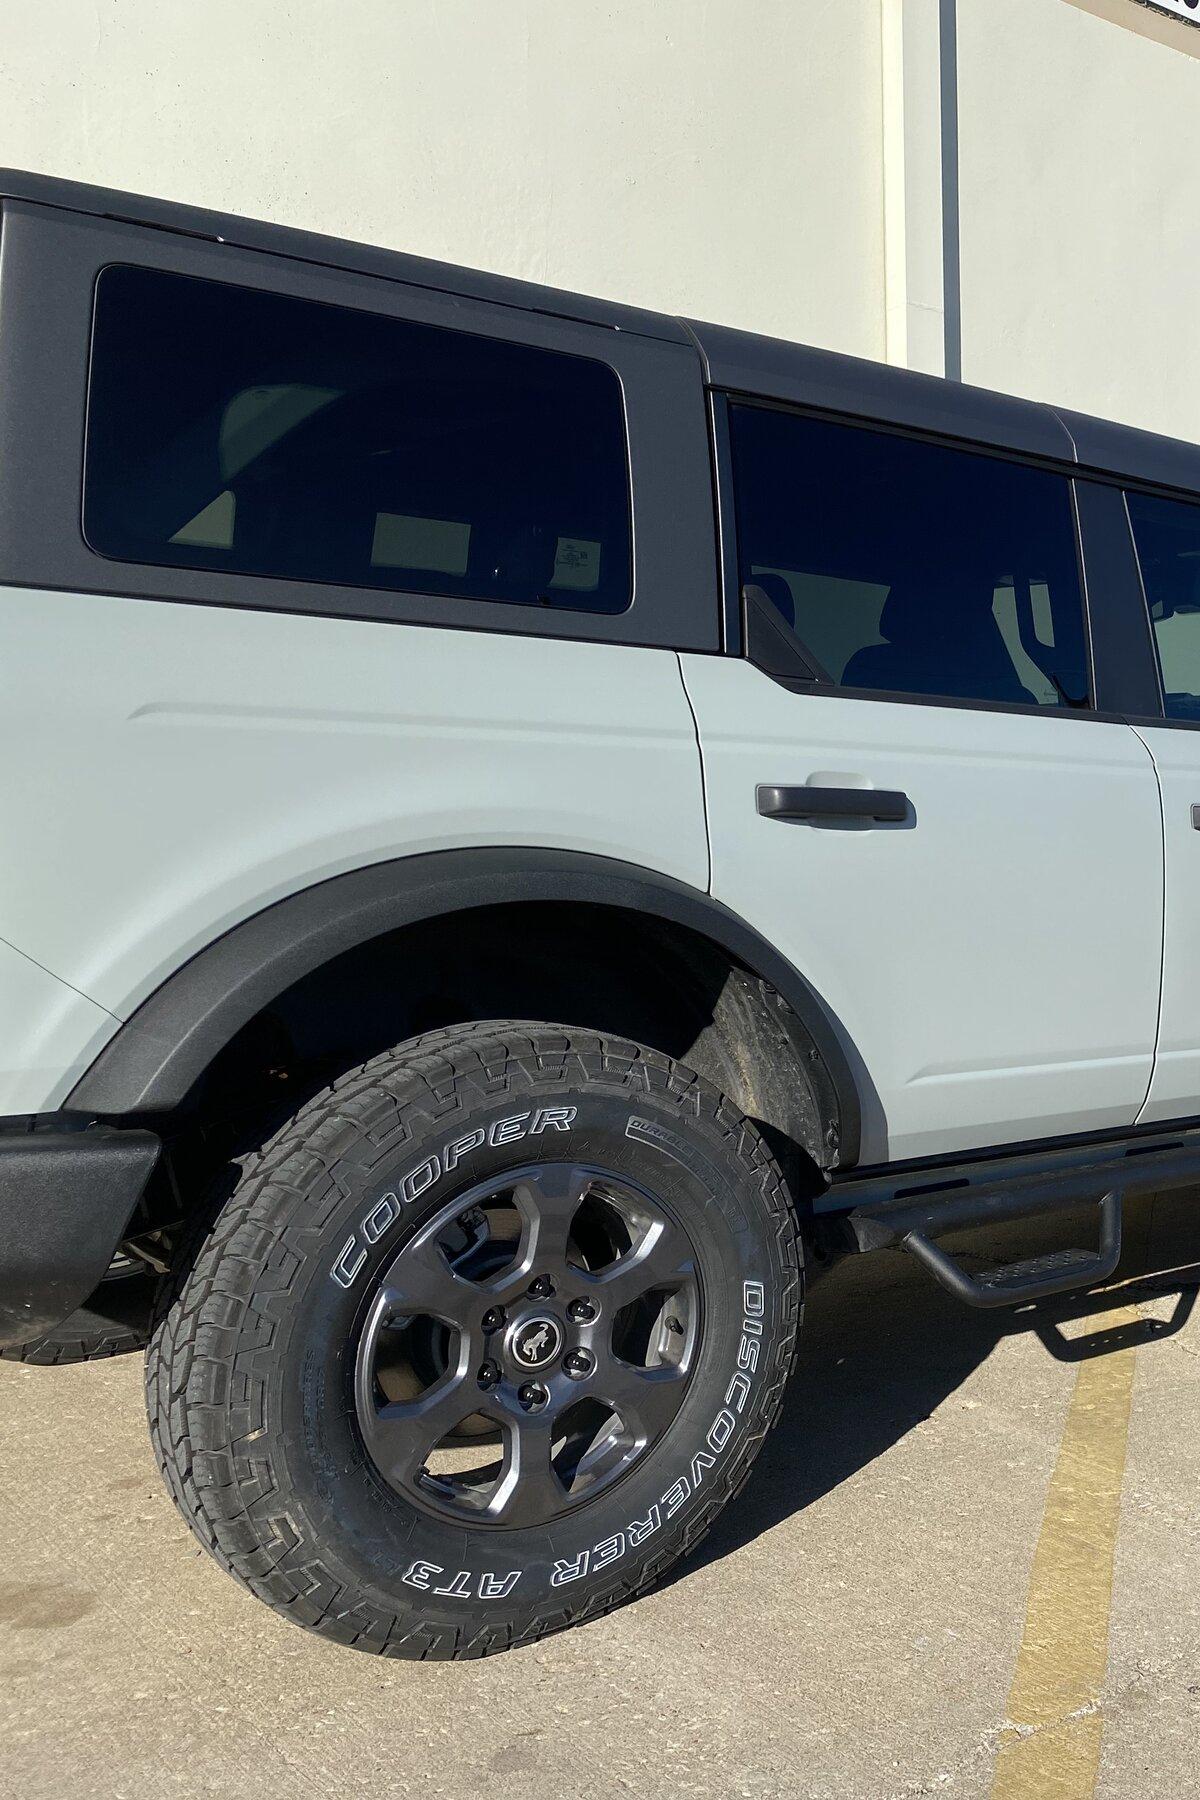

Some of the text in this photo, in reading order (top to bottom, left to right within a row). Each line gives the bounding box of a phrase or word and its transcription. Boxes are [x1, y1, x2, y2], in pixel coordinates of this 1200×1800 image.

[328, 1105, 578, 1289] COOPER
[550, 1278, 767, 1588] DISCOVERER
[401, 1558, 524, 1600] AT3
